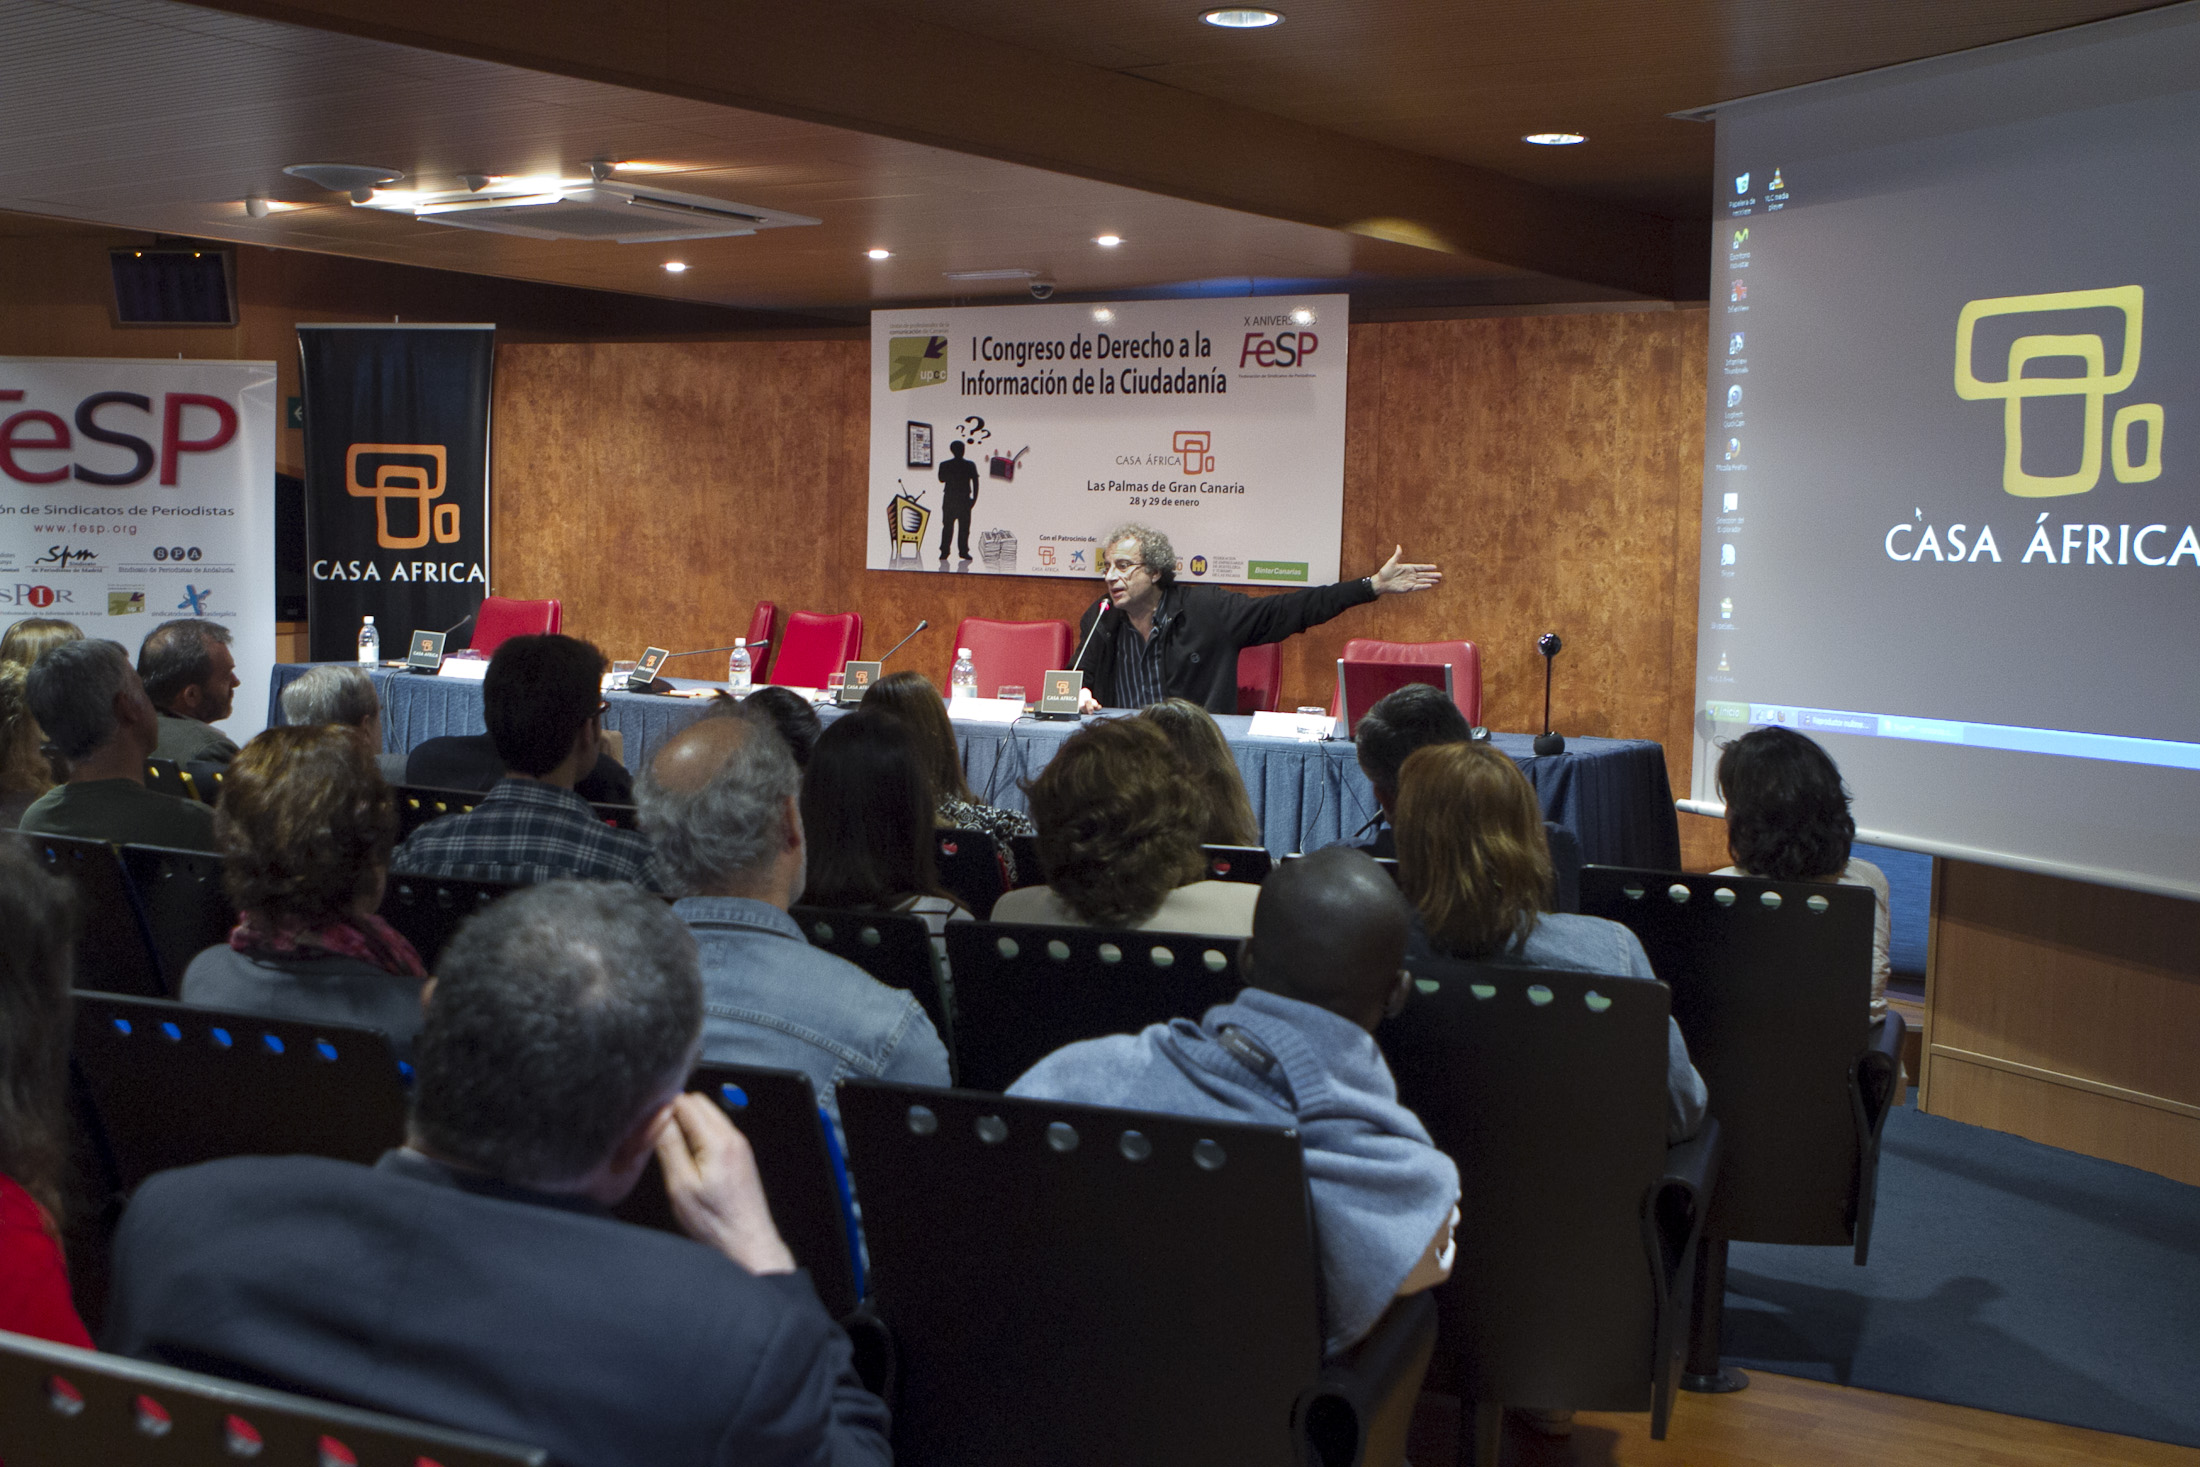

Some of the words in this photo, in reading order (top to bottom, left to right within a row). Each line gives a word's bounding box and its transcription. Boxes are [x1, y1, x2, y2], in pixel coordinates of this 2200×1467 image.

[1244, 316, 1251, 327] X
[972, 336, 977, 361] I
[981, 336, 1065, 367] Congreso
[1070, 333, 1092, 360] de
[1097, 331, 1174, 359] Derecho
[1179, 337, 1189, 358] a
[1195, 330, 1211, 358] la
[1239, 331, 1319, 368] FeSP
[920, 368, 946, 382] upcc
[961, 369, 1067, 396] Información
[1072, 368, 1095, 395] de
[1099, 368, 1115, 394] la
[1120, 367, 1227, 394] Ciudadanía
[1115, 456, 1142, 466] CASA
[1146, 454, 1182, 466] ÁFRICA
[1087, 480, 1106, 492] Las
[1108, 480, 1149, 493] Palmas
[1151, 481, 1166, 493] de
[1168, 481, 1197, 493] Gran
[1199, 482, 1245, 494] Canaria
[1129, 496, 1140, 506] 28
[1142, 498, 1147, 508] y
[1149, 497, 1160, 506] 29
[1161, 497, 1173, 506] de
[1174, 499, 1200, 507] enero
[20, 504, 40, 516] de
[44, 504, 125, 516] Sindicatos
[128, 505, 148, 516] de
[152, 506, 235, 517] Periodistas
[34, 523, 138, 535] www.fesp.org
[1884, 523, 2002, 563] CASA
[2021, 512, 2200, 566] ÁFRICA
[313, 560, 381, 581] CASA
[390, 561, 485, 583] AFRICA
